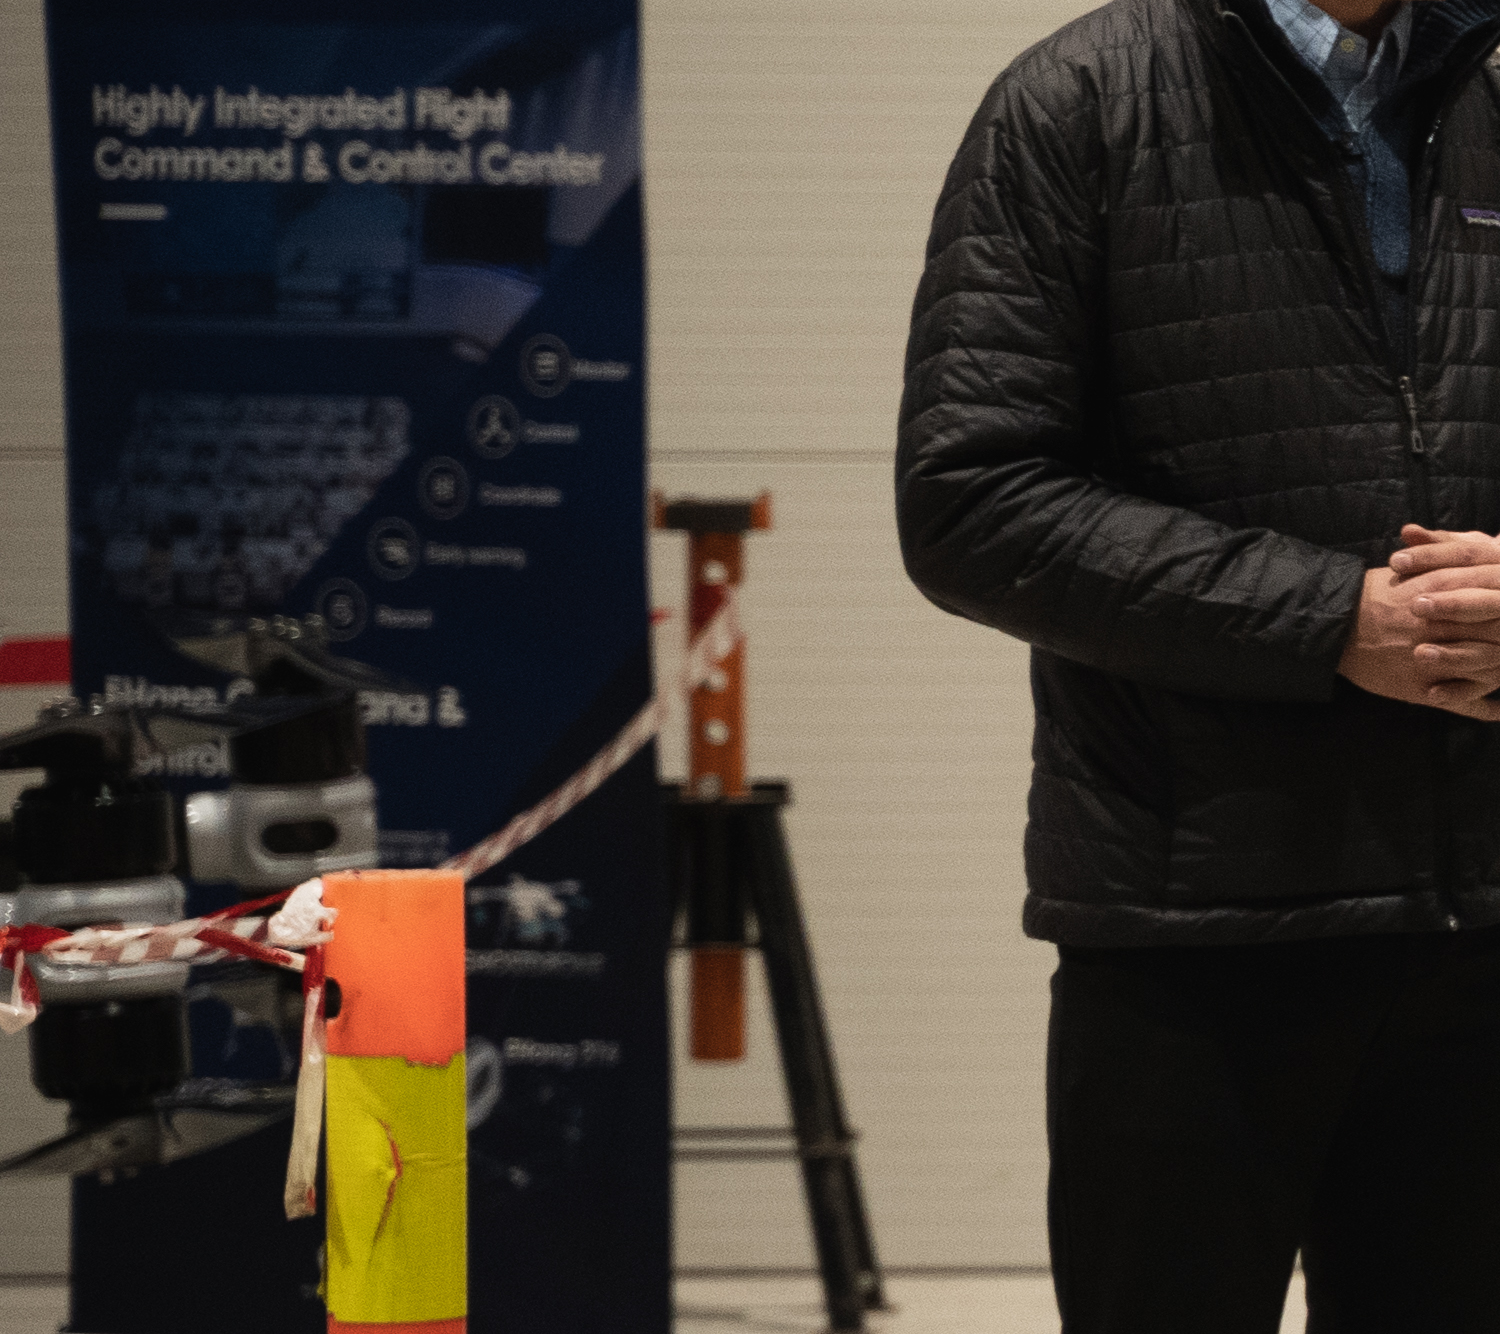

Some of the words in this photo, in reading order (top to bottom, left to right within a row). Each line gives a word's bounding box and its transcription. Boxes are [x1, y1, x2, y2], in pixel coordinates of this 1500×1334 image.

[93, 84, 206, 136] Highly
[214, 84, 406, 138] Integrated
[415, 86, 511, 140] Flight
[95, 137, 294, 183] Command
[302, 140, 330, 183] &
[338, 140, 472, 185] Control
[480, 141, 604, 186] Center
